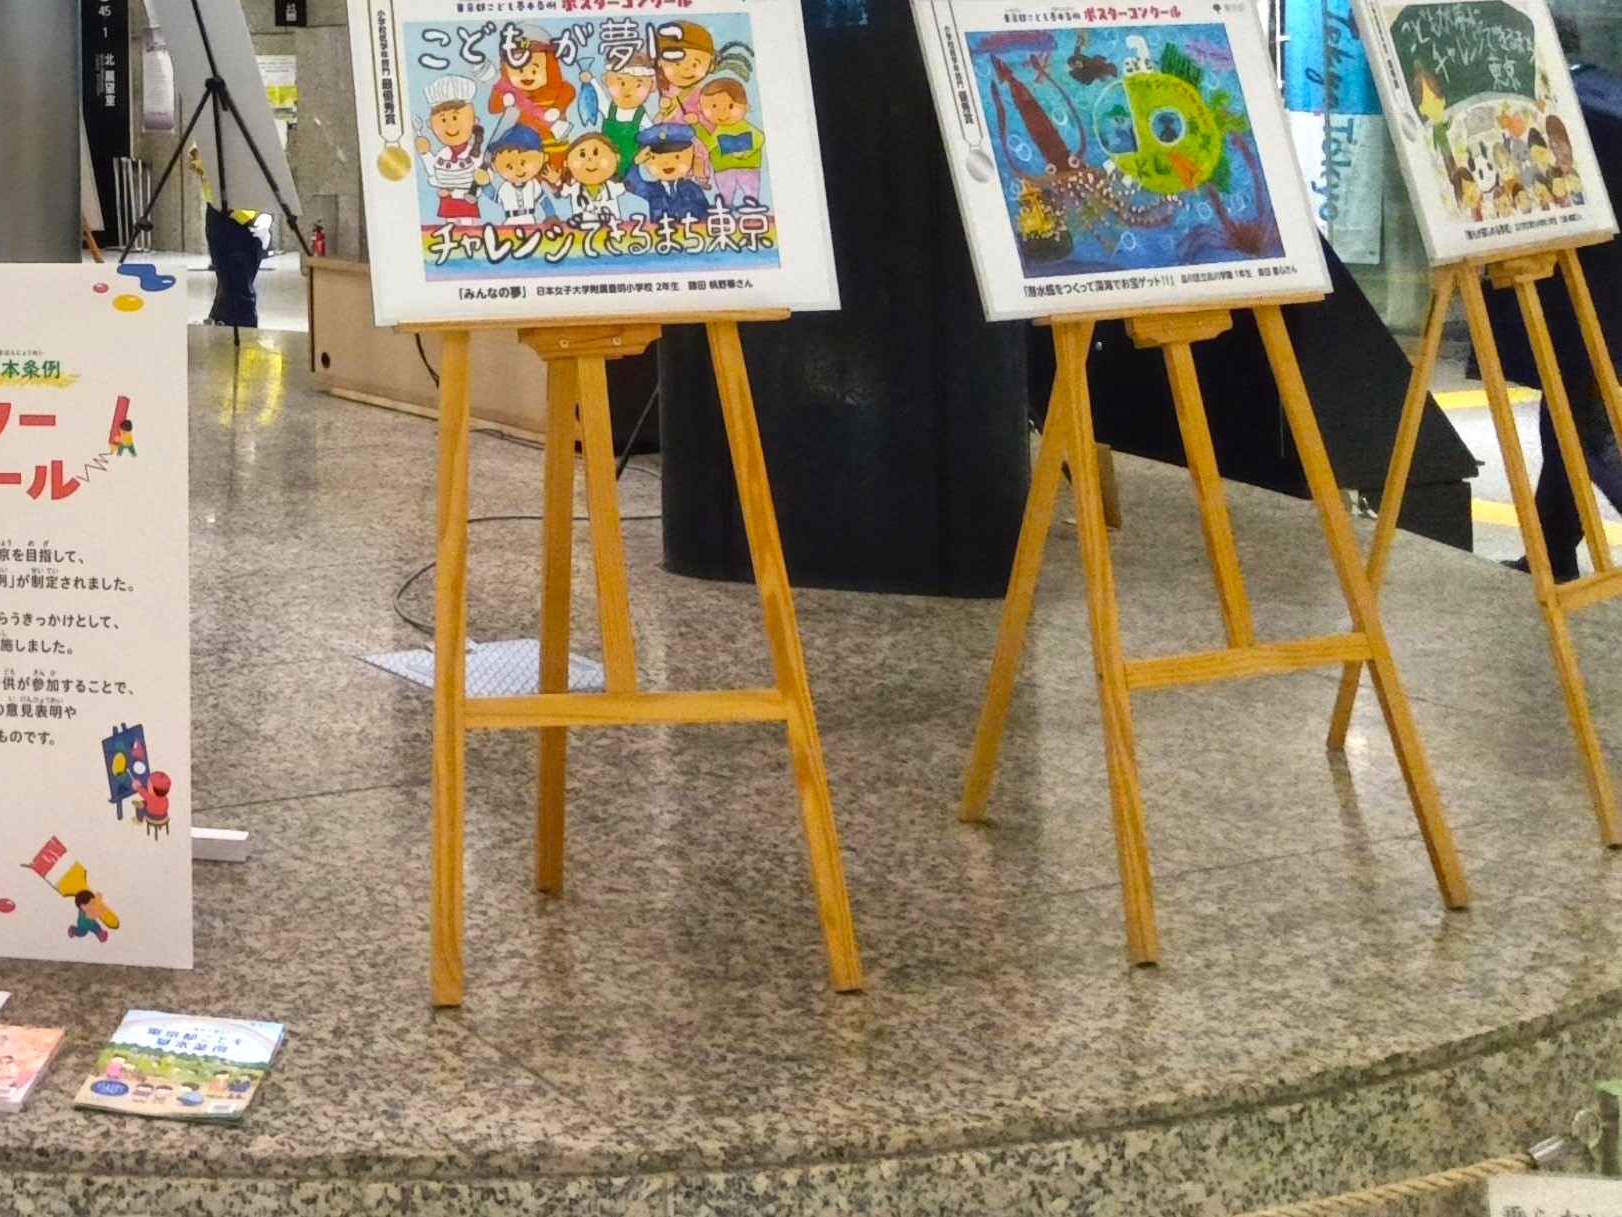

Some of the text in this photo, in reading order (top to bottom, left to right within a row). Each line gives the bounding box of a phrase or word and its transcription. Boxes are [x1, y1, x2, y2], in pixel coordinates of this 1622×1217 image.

[99, 6, 112, 16] 45
[1084, 5, 1182, 22] ポスターコンクール
[418, 17, 686, 72] こどもが夢に
[382, 77, 396, 125] 最優秀賞
[429, 195, 774, 265] チャレンジできるまち東京
[459, 286, 527, 299] 「みんなの夢」
[656, 281, 679, 292] 2年生
